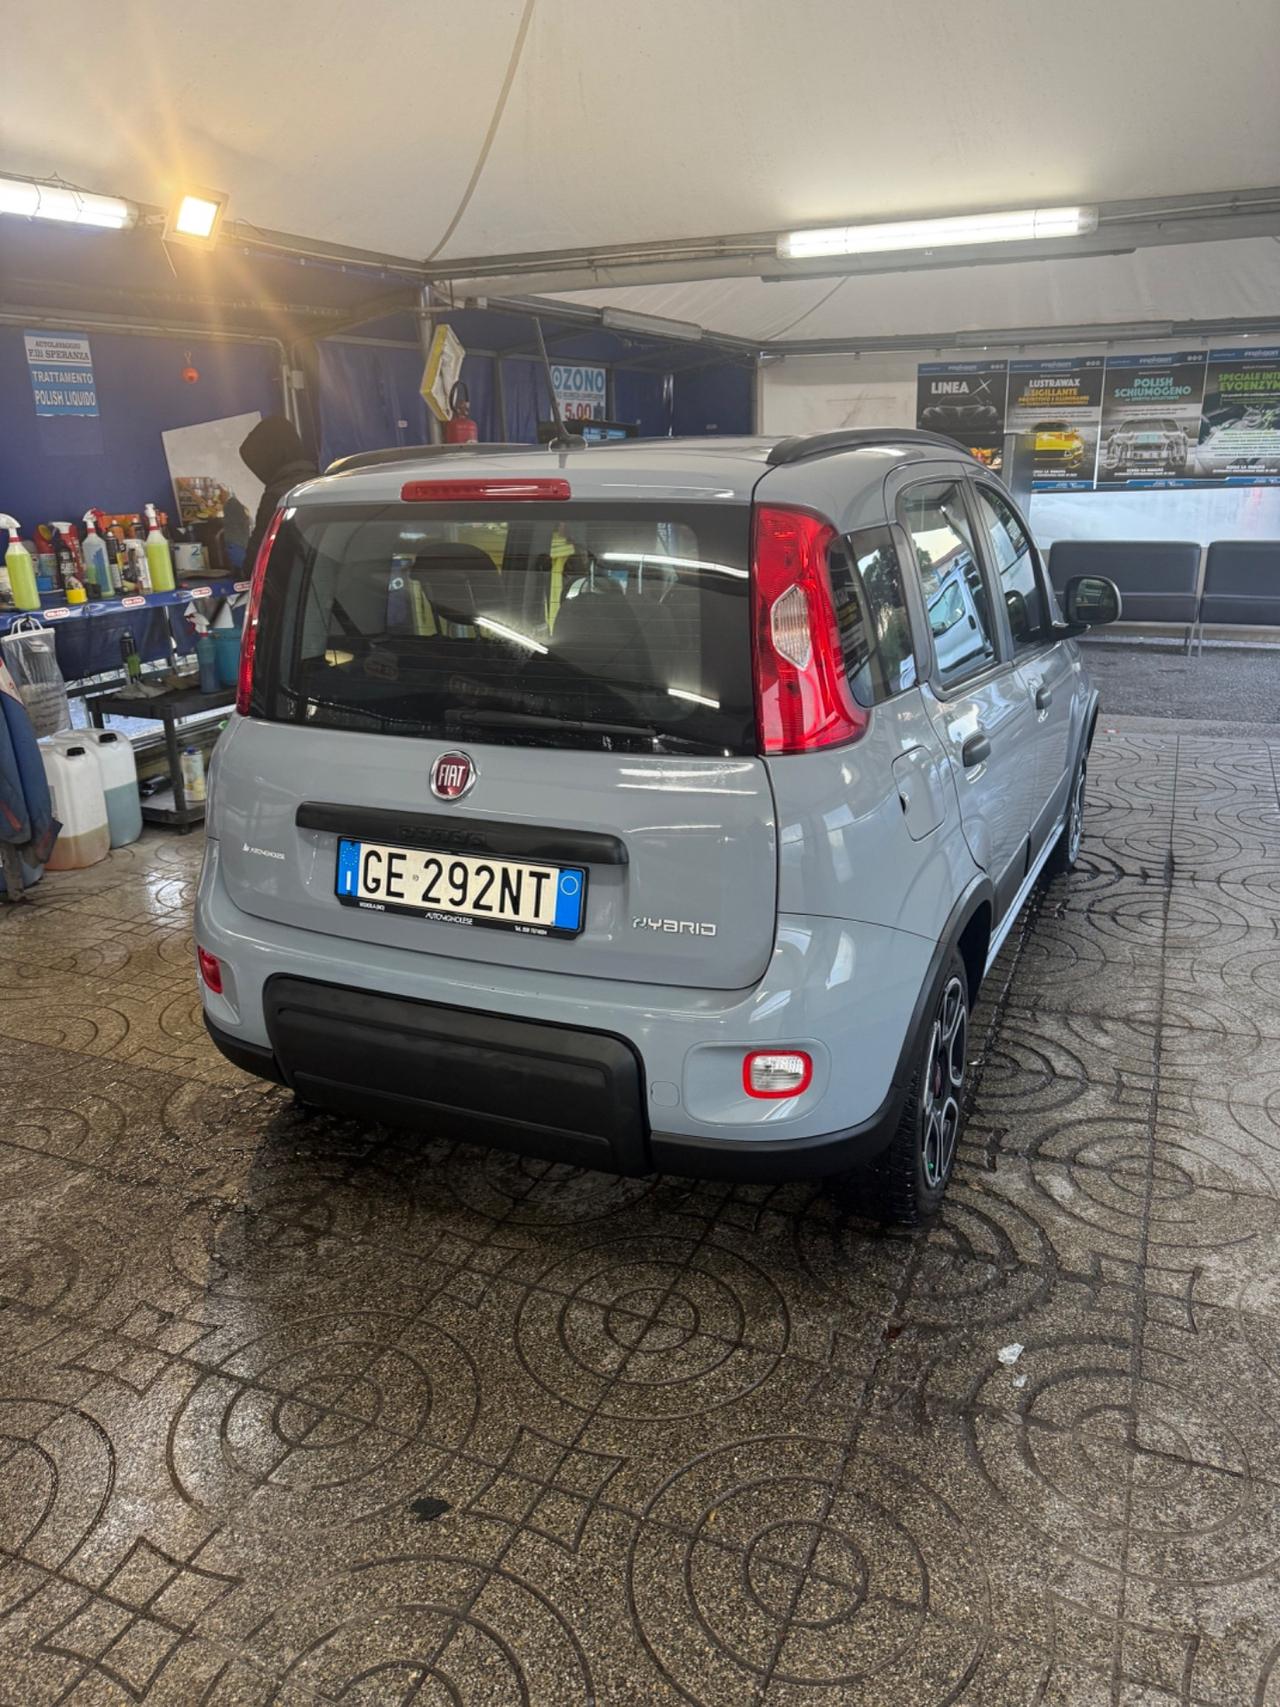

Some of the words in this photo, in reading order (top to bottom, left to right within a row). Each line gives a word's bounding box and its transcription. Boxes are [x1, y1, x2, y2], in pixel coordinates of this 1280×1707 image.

[45, 349, 90, 361] SPERANZA
[31, 371, 94, 384] TRATTAMENTO
[552, 367, 604, 393] OZONO
[1029, 378, 1081, 388] LUSTRAWAX
[1133, 377, 1174, 388] POLISH
[1218, 371, 1261, 382] SPECIALE
[931, 381, 970, 394] LINEA
[1114, 386, 1192, 398] SCHIUMOGENO
[34, 390, 64, 406] POLISH
[65, 391, 96, 406] LIQUIDO
[438, 764, 466, 787] FIAT
[363, 849, 407, 898] GE
[421, 858, 551, 918] 292NT
[633, 916, 717, 936] HYBRID
